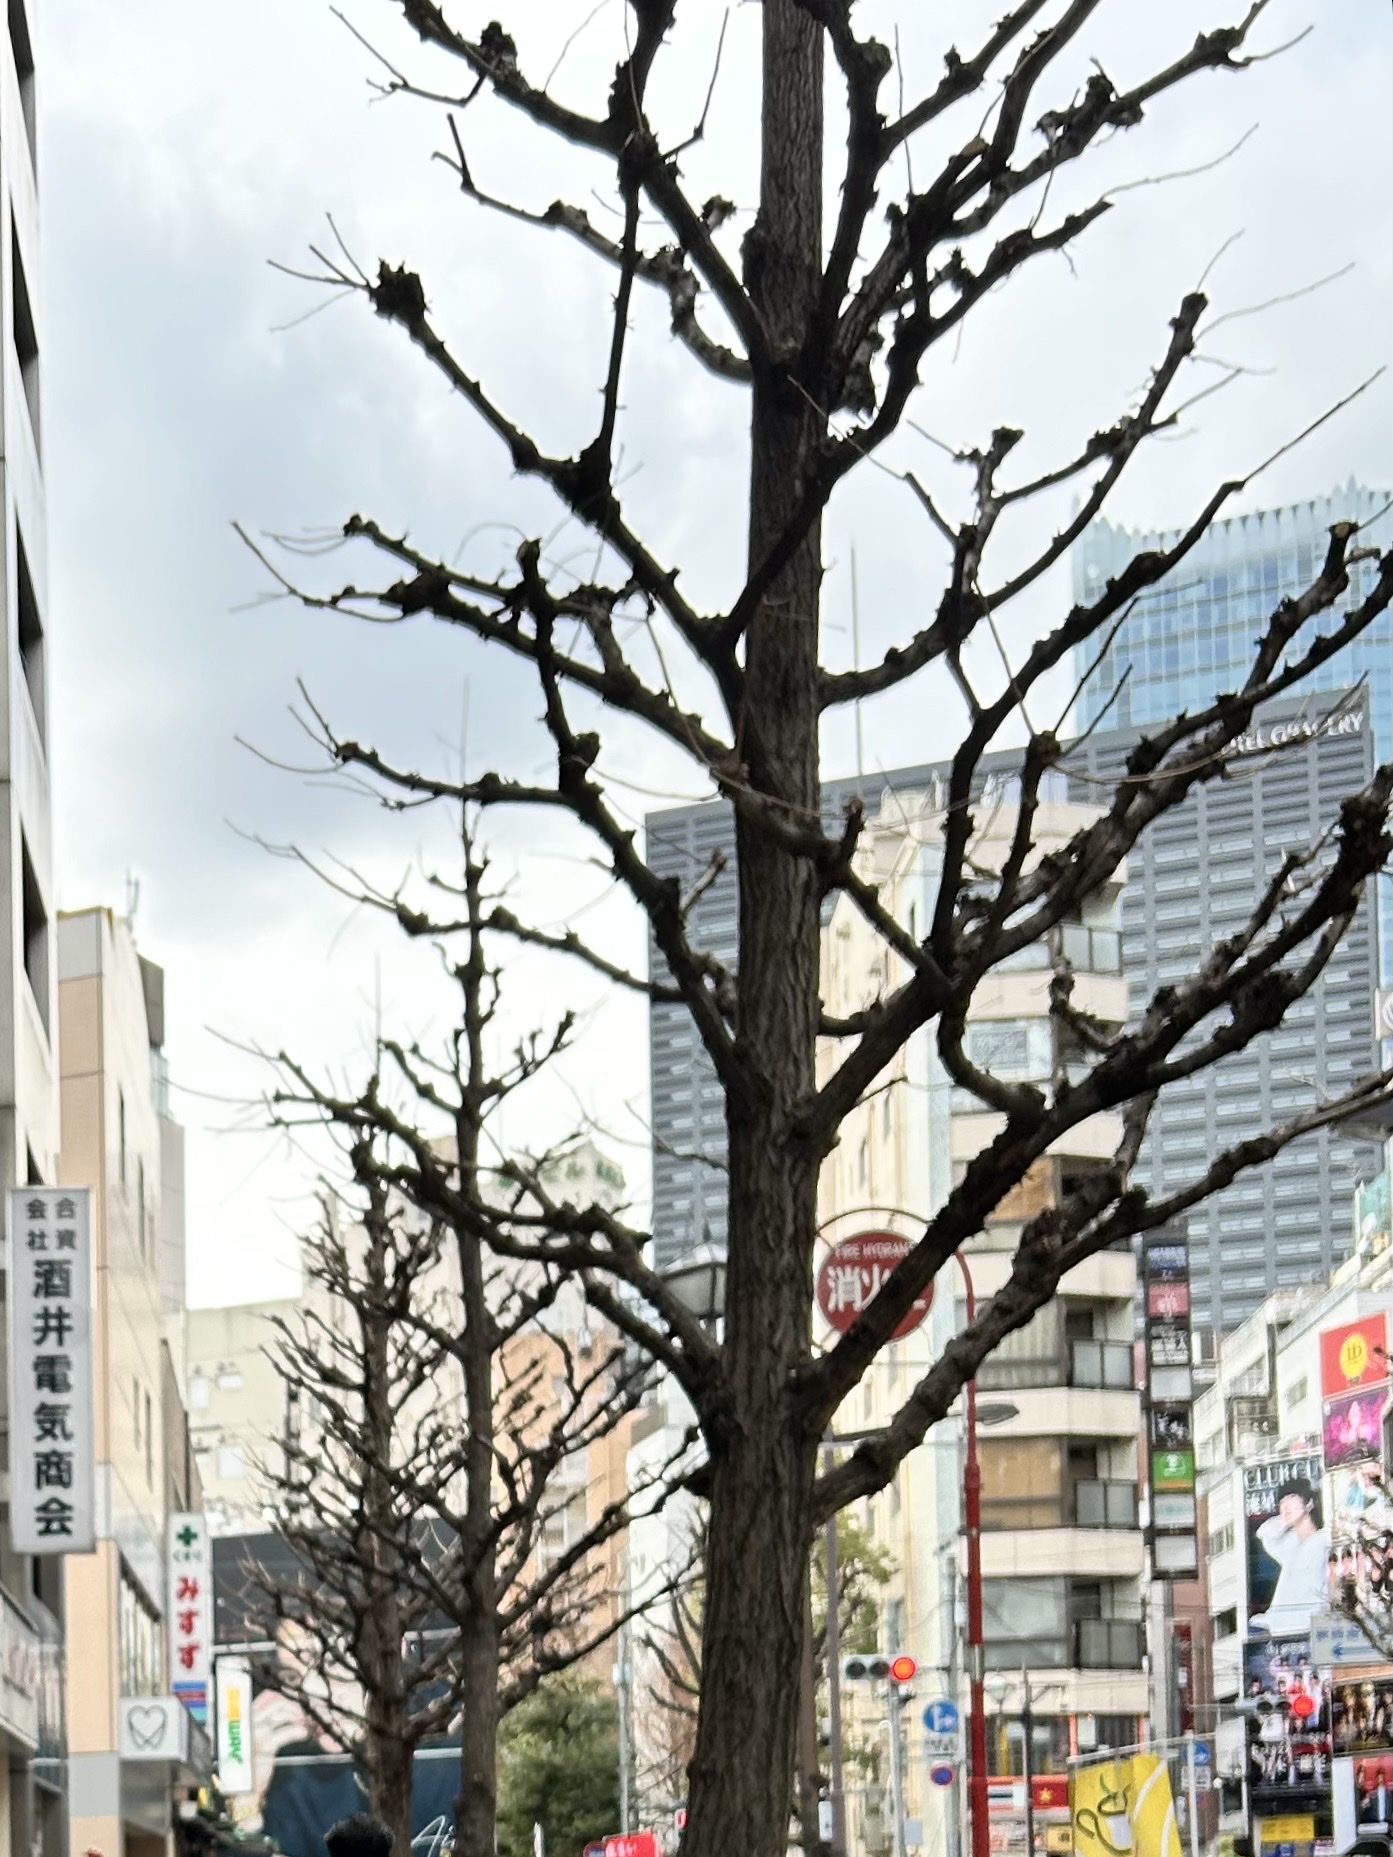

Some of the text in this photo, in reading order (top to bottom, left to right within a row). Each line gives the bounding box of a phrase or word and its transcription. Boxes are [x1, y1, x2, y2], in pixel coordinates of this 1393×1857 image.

[862, 1242, 914, 1259] HYDRAN
[826, 1264, 926, 1312] 消火
[33, 1259, 74, 1536] 酒井電気商会
